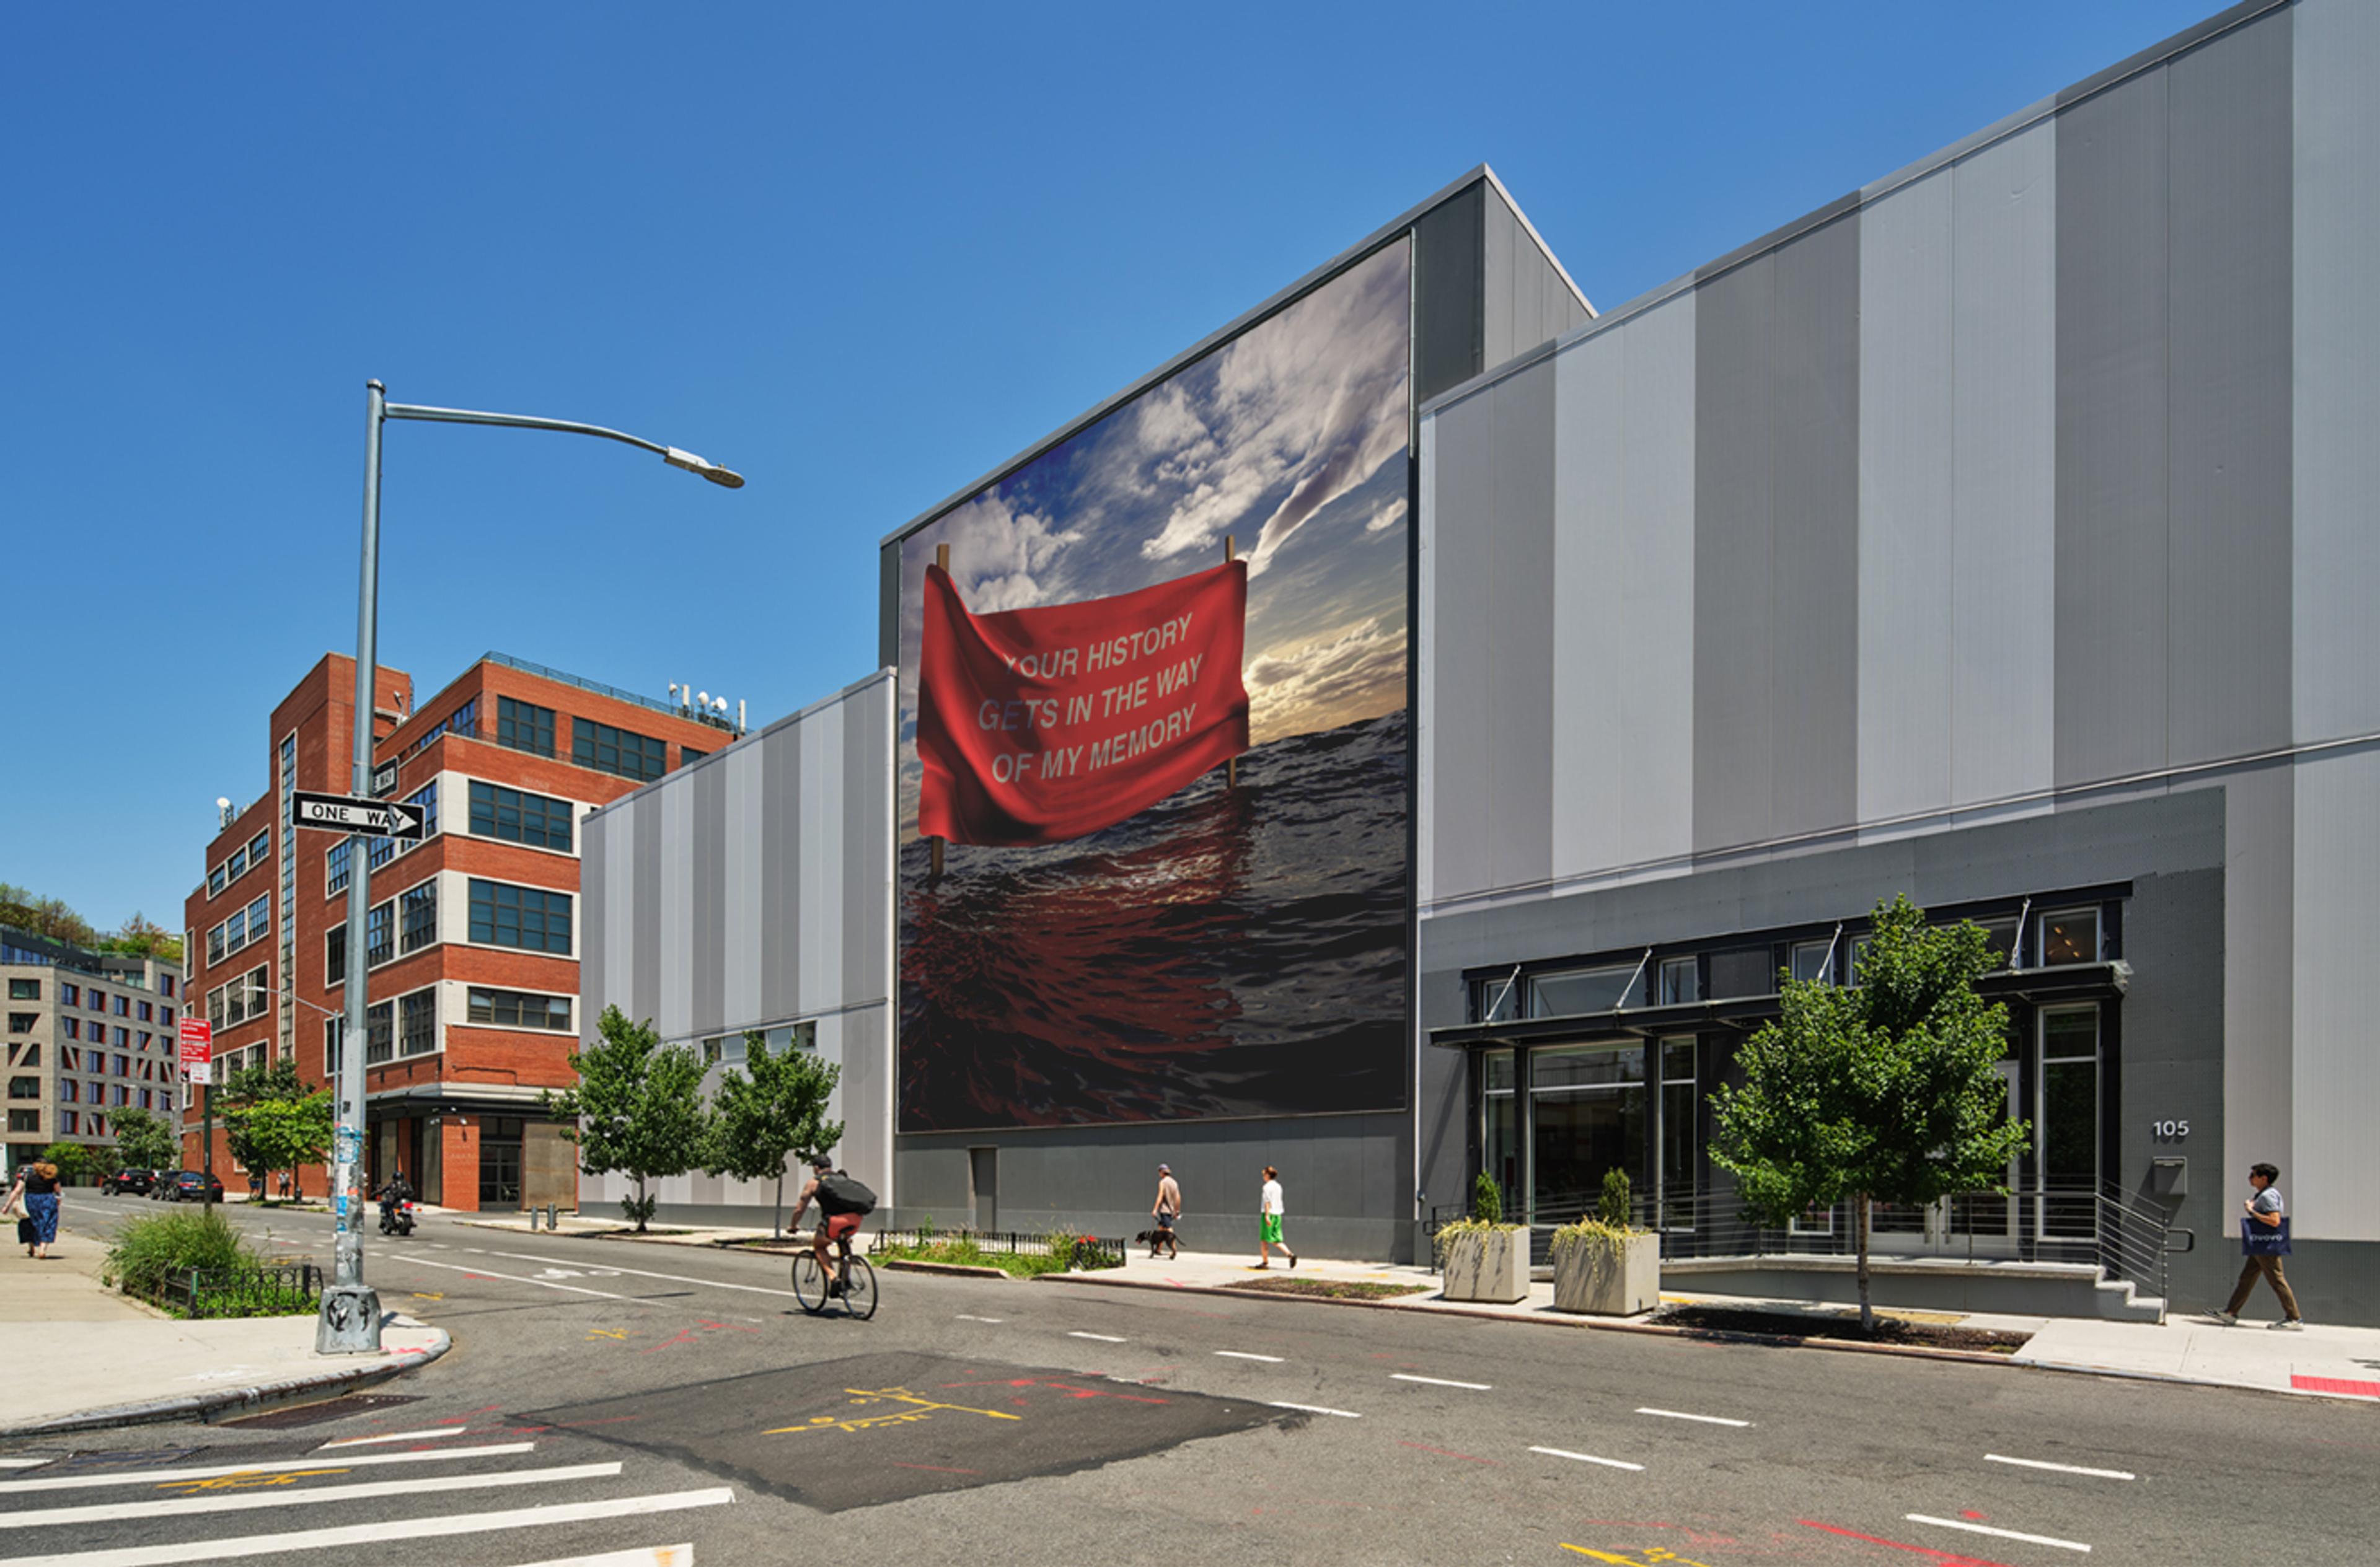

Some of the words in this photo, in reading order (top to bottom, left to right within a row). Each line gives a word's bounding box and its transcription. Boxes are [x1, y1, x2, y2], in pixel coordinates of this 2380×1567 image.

[1002, 647, 1078, 679] YOUR
[1086, 613, 1193, 674] HISTORY
[979, 697, 1058, 731] GETS
[1066, 693, 1092, 726] IN
[1101, 677, 1148, 718] THE
[1157, 654, 1203, 697] WAY
[992, 752, 1033, 783] OF
[1041, 745, 1085, 779] MY
[1089, 703, 1197, 770] MEMORY
[312, 803, 349, 822] ONE
[367, 811, 405, 828] WAY
[2153, 1120, 2190, 1136] 105
